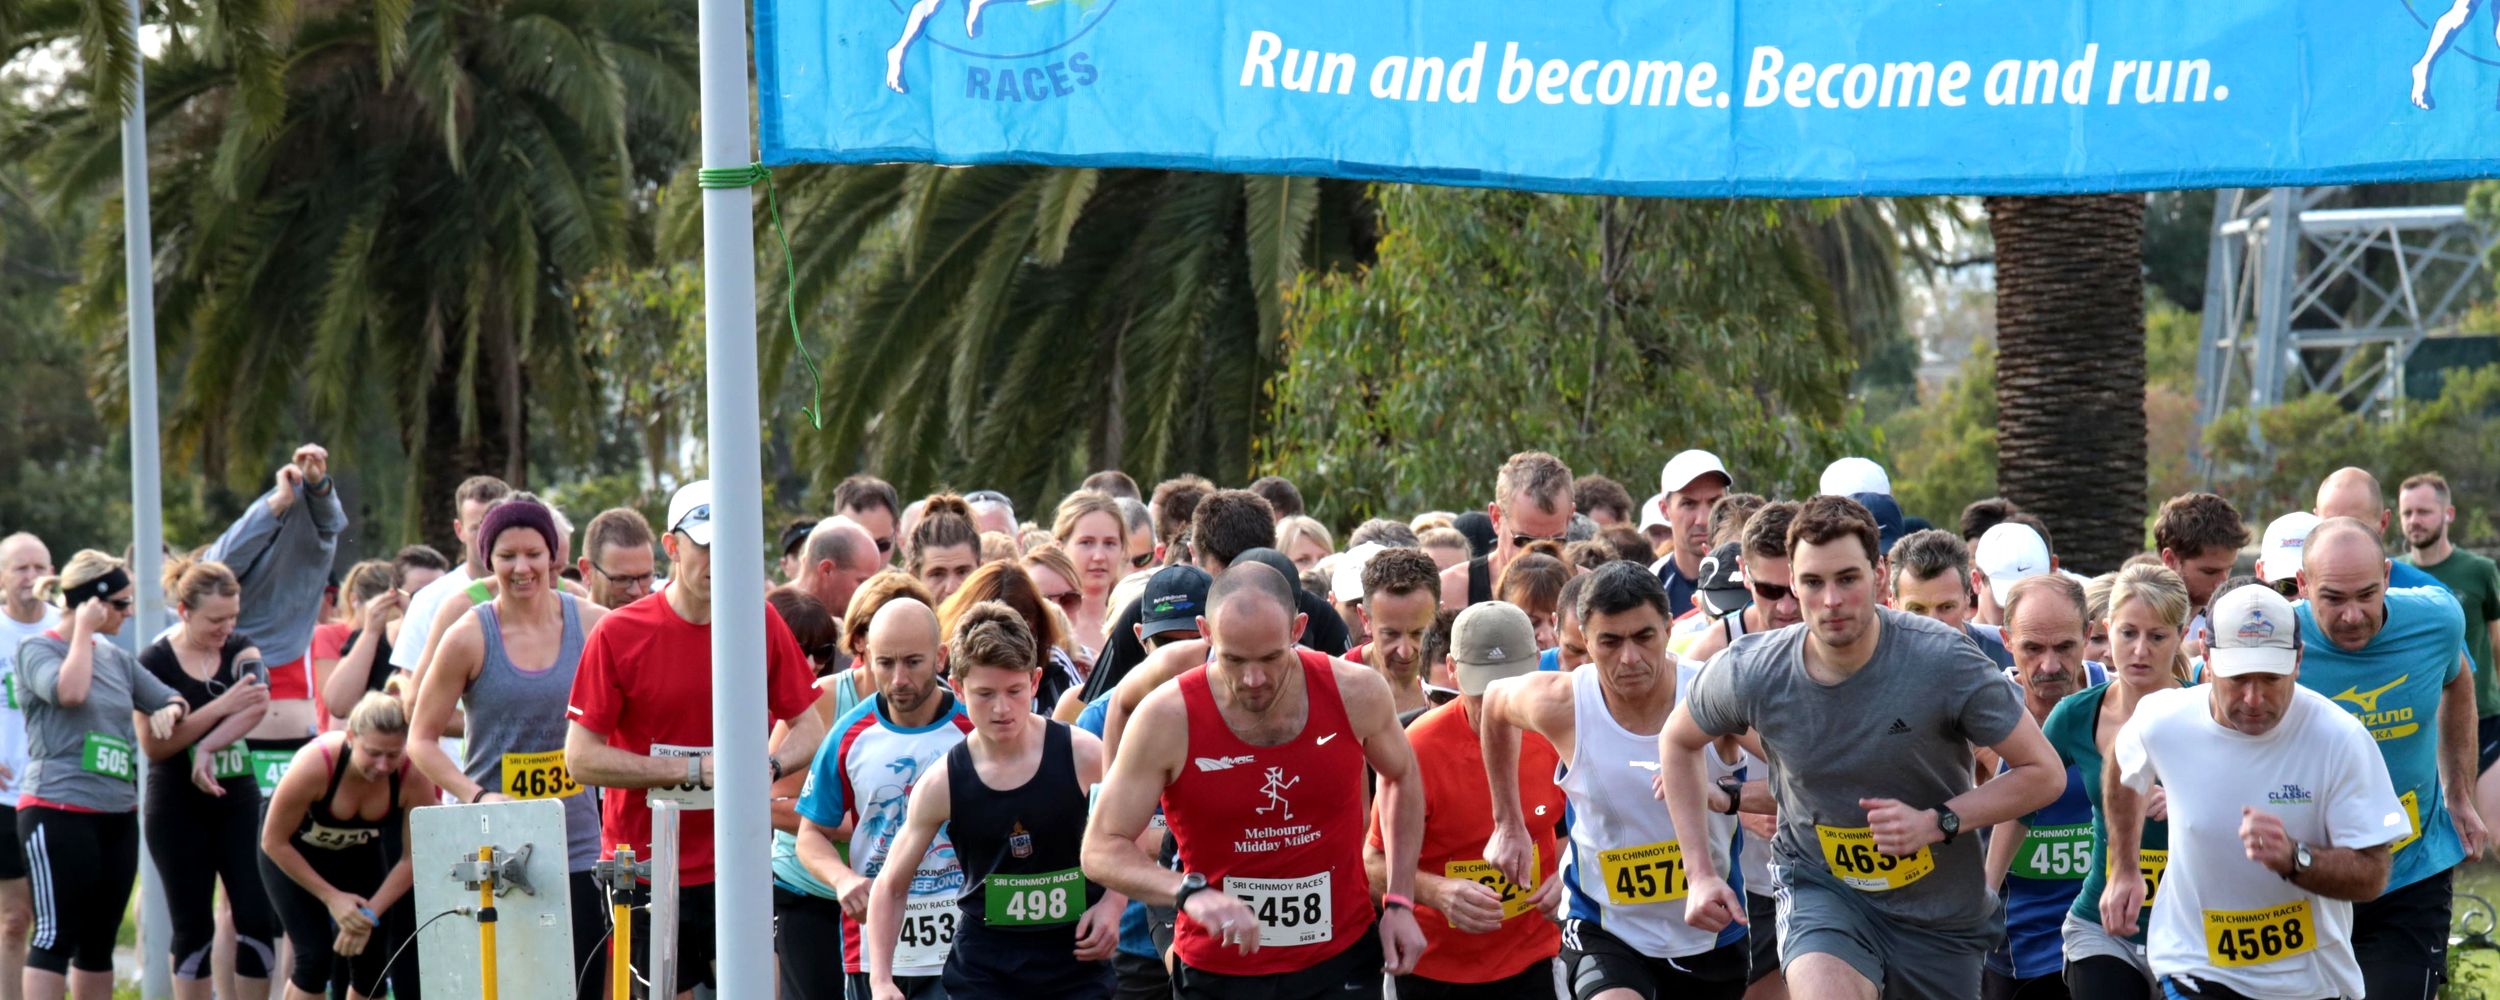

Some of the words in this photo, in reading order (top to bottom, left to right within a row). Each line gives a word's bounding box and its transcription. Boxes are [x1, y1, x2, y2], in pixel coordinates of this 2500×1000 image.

[965, 51, 1099, 103] RACES
[1239, 30, 1356, 95] Run
[1369, 41, 1487, 103] and
[1497, 41, 1730, 109] become.
[1743, 45, 1971, 109] Become
[1983, 42, 2099, 106] and
[2107, 57, 2229, 104] run.
[523, 755, 558, 764] CHINMOY
[658, 748, 671, 756] SRI
[96, 745, 129, 776] 505
[2268, 790, 2312, 799] CLASSIC
[1245, 823, 1312, 840] Melbourne
[1824, 830, 1837, 839] SRI
[1838, 831, 1874, 841] CHINMO
[2033, 829, 2075, 838] CHINMOY
[2076, 827, 2095, 836] RAC
[1234, 840, 1281, 853] Midday
[1284, 829, 1322, 848] Milers
[1607, 854, 1621, 862] SRI
[1622, 847, 1665, 860] CHINMOY
[2030, 841, 2092, 875] 455
[1453, 864, 1467, 873] SRI
[993, 878, 1007, 886] SRI
[1009, 877, 1050, 887] CHINMOY
[1053, 871, 1079, 884] RACES
[1232, 881, 1246, 889] SRI
[1249, 882, 1293, 891] CHINMOY
[1296, 878, 1324, 890] RACES
[930, 899, 955, 909] RACES
[1006, 887, 1067, 921] 498
[2211, 914, 2224, 923] SRI
[2226, 912, 2271, 923] CHINMOY
[2273, 904, 2303, 918] RACES
[900, 913, 955, 947] 453
[1300, 934, 1316, 942] 5458
[2217, 918, 2304, 961] 4568
